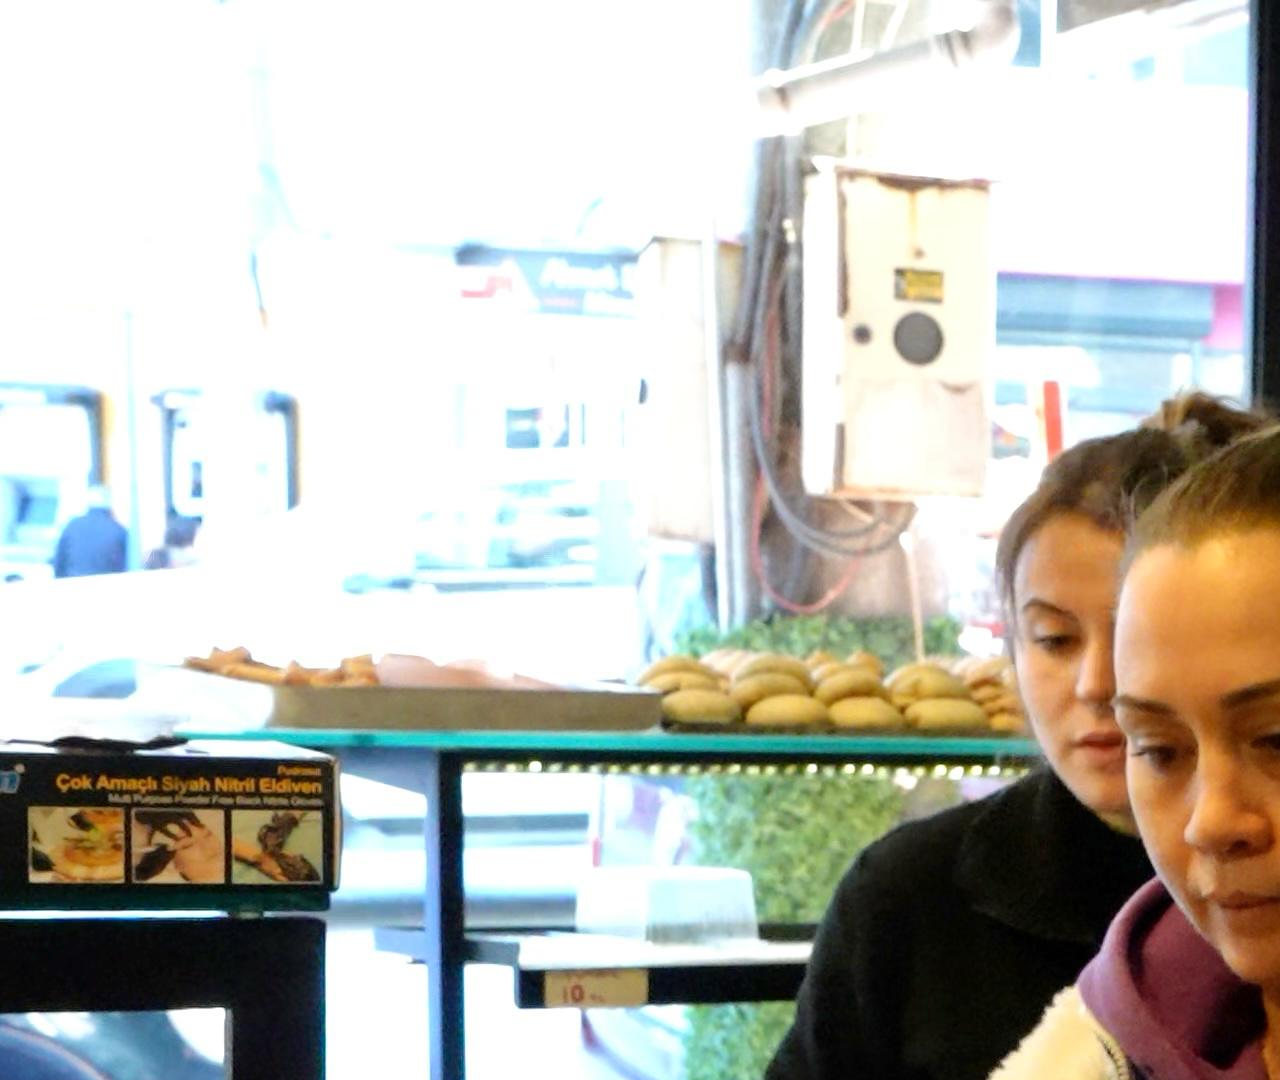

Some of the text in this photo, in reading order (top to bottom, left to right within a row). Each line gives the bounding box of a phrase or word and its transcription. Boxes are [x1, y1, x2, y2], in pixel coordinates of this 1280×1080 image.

[56, 773, 91, 792] Çok
[162, 775, 210, 796] Siyah
[215, 777, 255, 793] Nitril
[259, 778, 322, 794] Eldiven
